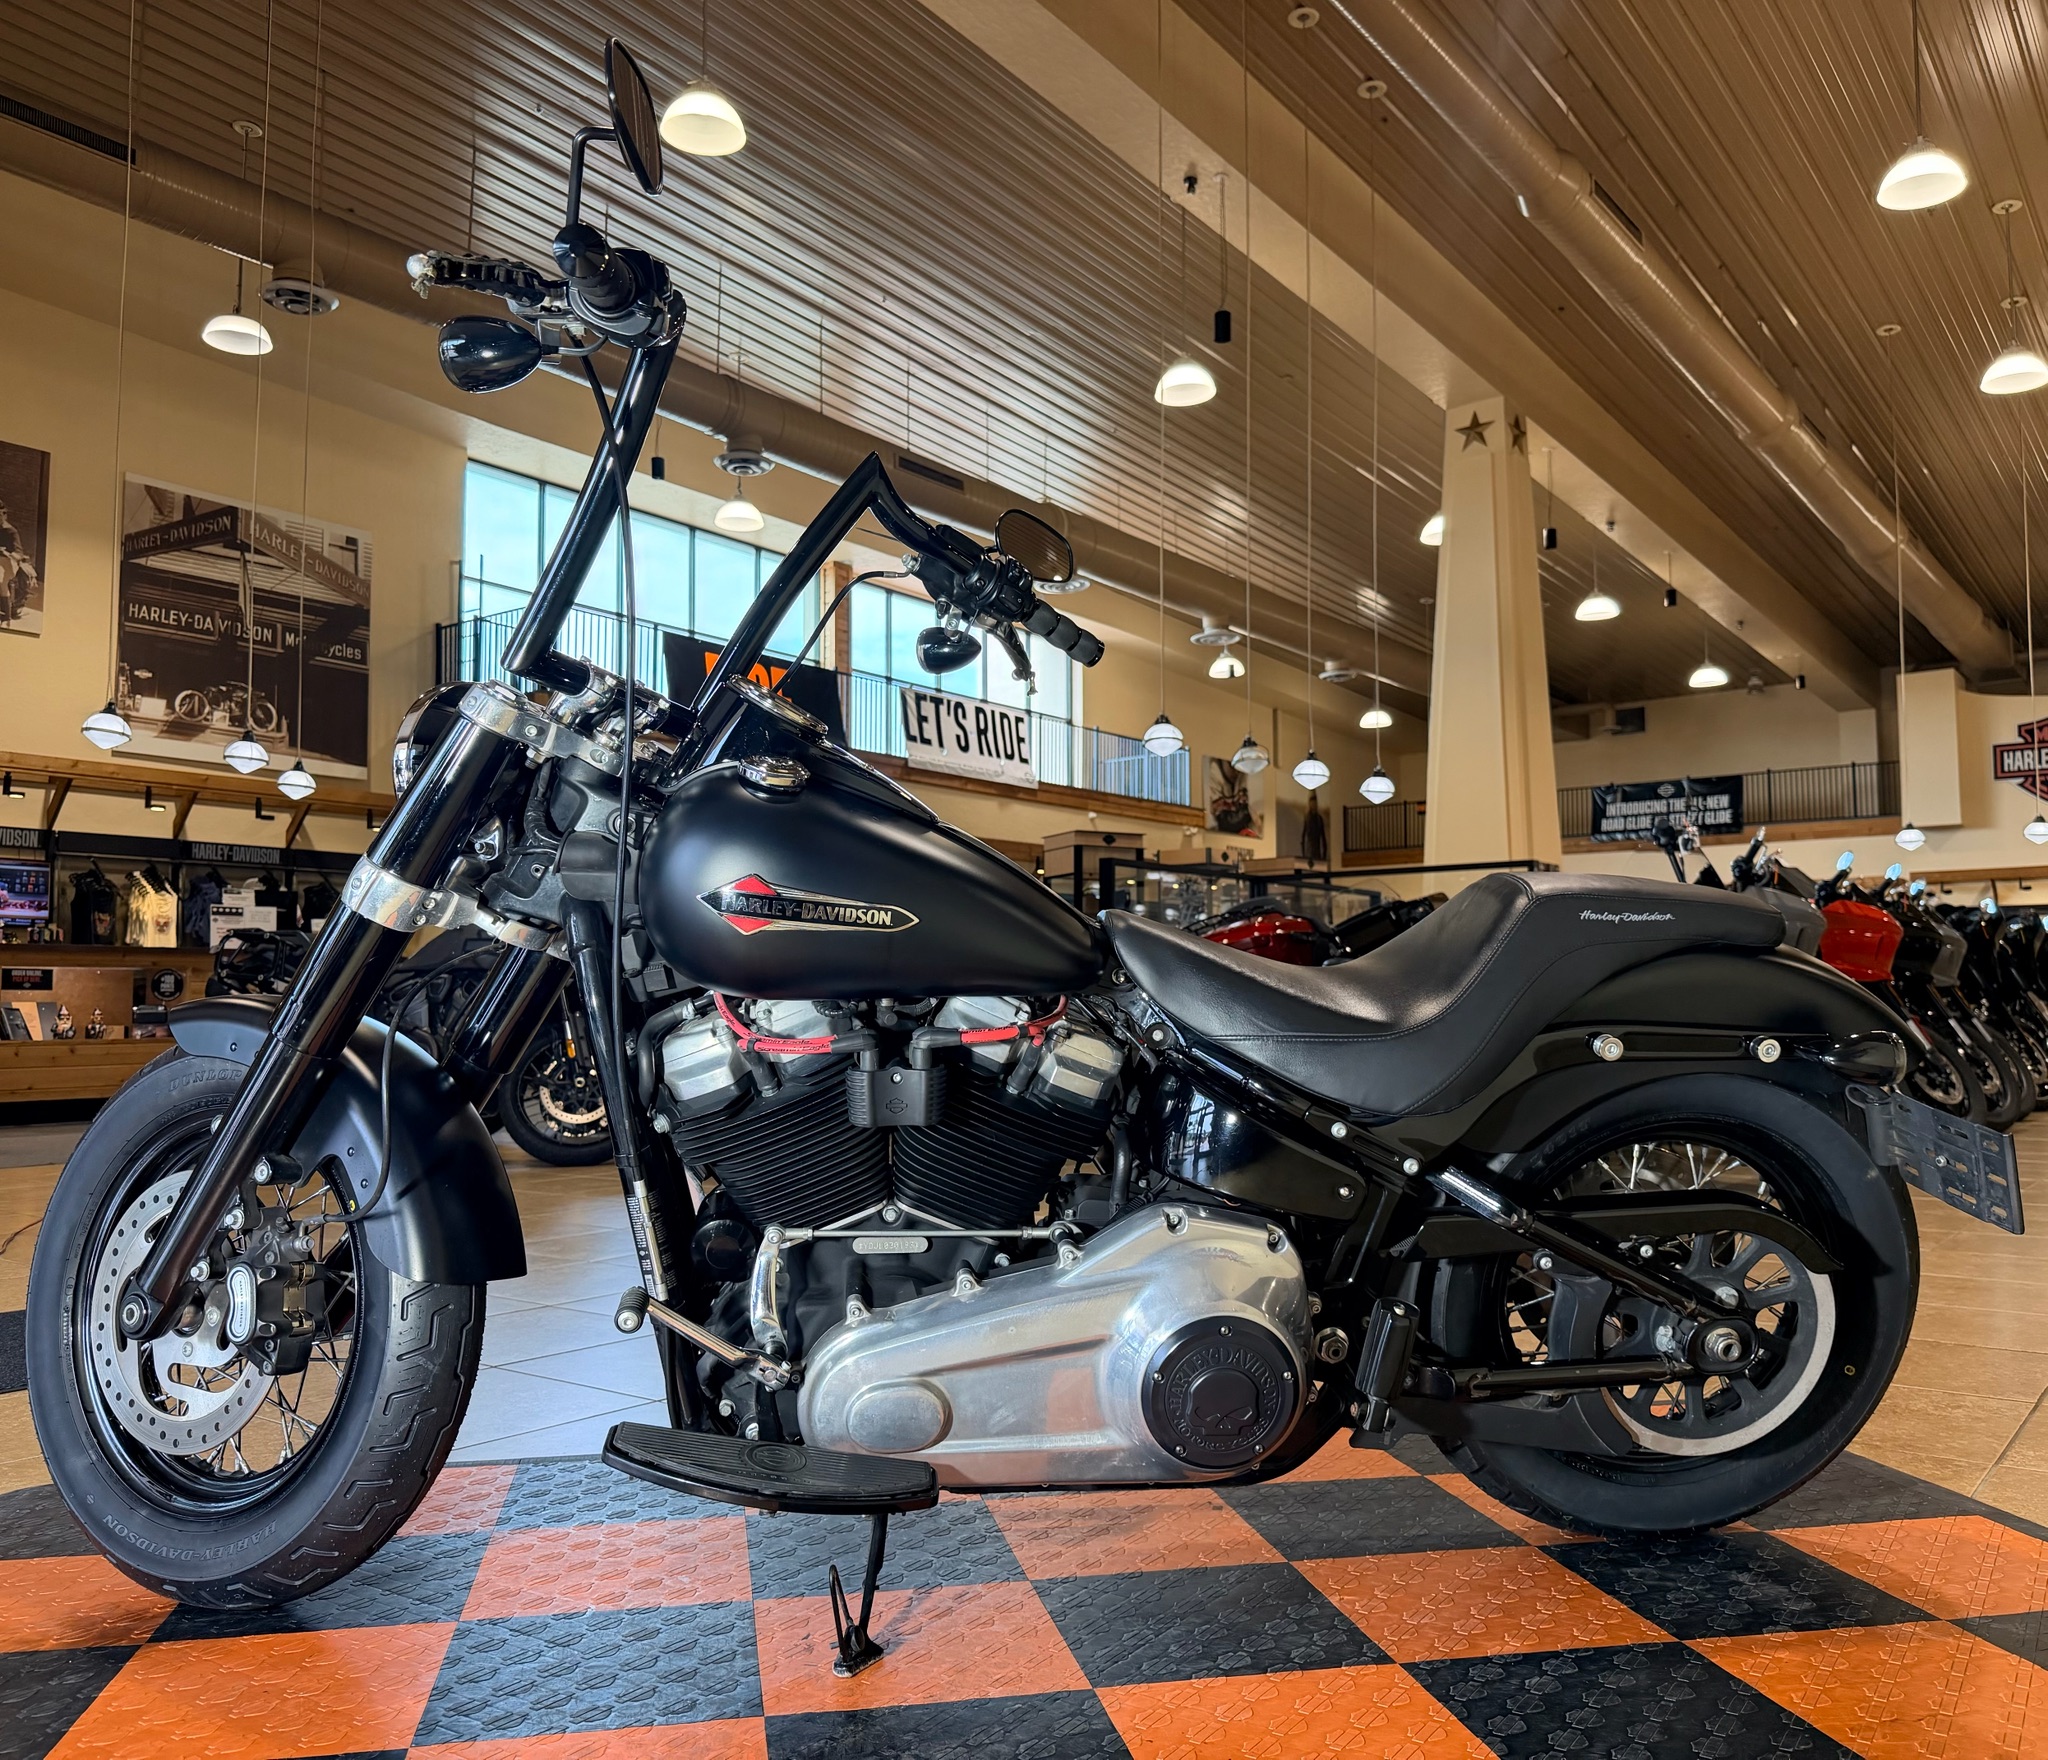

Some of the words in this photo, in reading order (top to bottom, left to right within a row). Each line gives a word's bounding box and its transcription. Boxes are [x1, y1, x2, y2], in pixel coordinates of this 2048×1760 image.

[126, 515, 232, 552] HARLEY-DAVIDSON
[128, 602, 273, 644] HARLEY-DAVIDSON
[901, 692, 970, 753] LET'S
[974, 705, 1029, 764] RIDE
[1601, 817, 1625, 832] ROAD
[1626, 815, 1651, 830] GLIDE
[1704, 809, 1733, 824] GLIDE
[1606, 799, 1668, 817] INTRODUCING
[1669, 797, 1686, 813] THE
[192, 843, 280, 864] HARLEY-DAVIDSON
[720, 893, 892, 925] HARLEY-DAVIDSON
[1579, 909, 1676, 924] Harley-Davidson
[168, 1068, 243, 1092] DUNLOP
[102, 1514, 278, 1562] HARLEY-DAVIDSON
